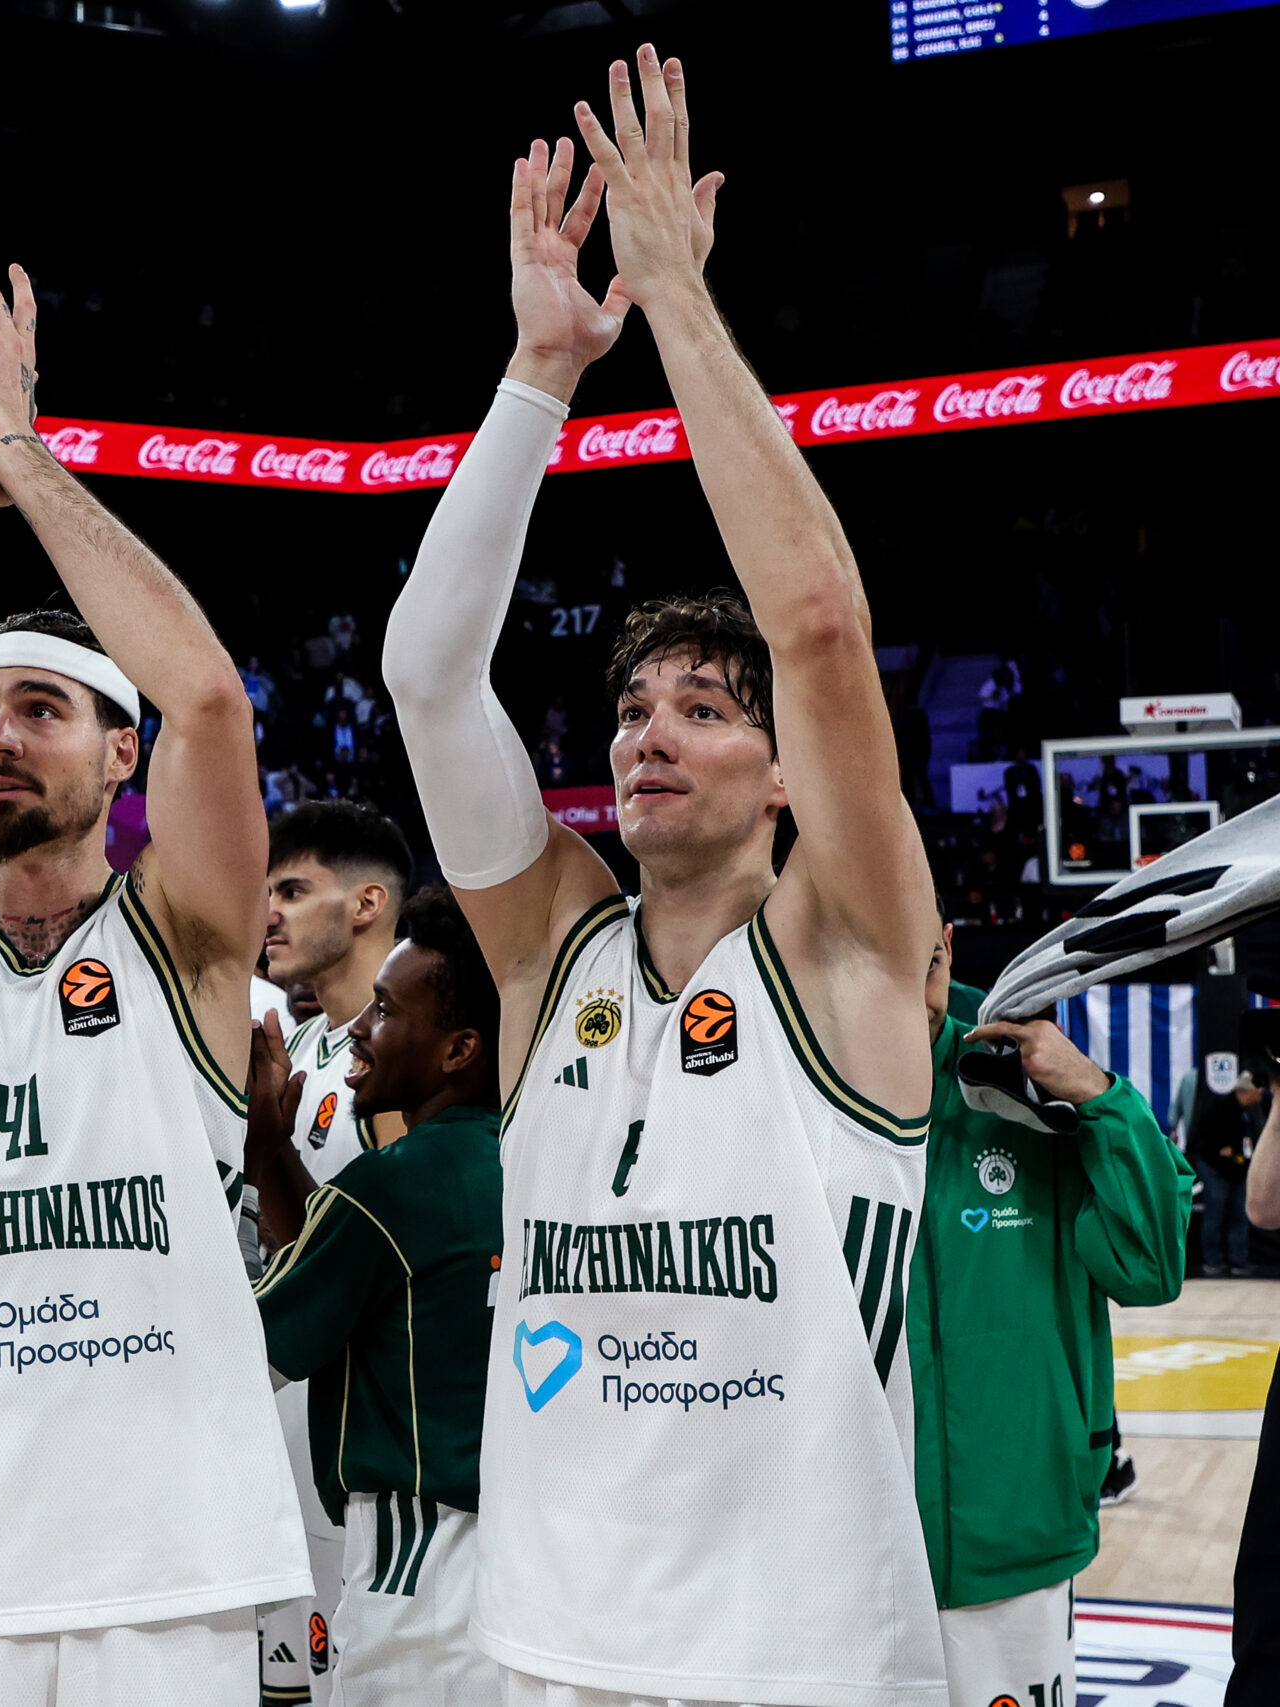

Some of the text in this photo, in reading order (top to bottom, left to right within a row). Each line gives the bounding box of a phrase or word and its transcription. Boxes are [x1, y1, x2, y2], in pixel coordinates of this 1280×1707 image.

[551, 604, 601, 637] 217
[598, 1331, 697, 1369] Ομάδα
[603, 1368, 785, 1411] Προσφοράς
